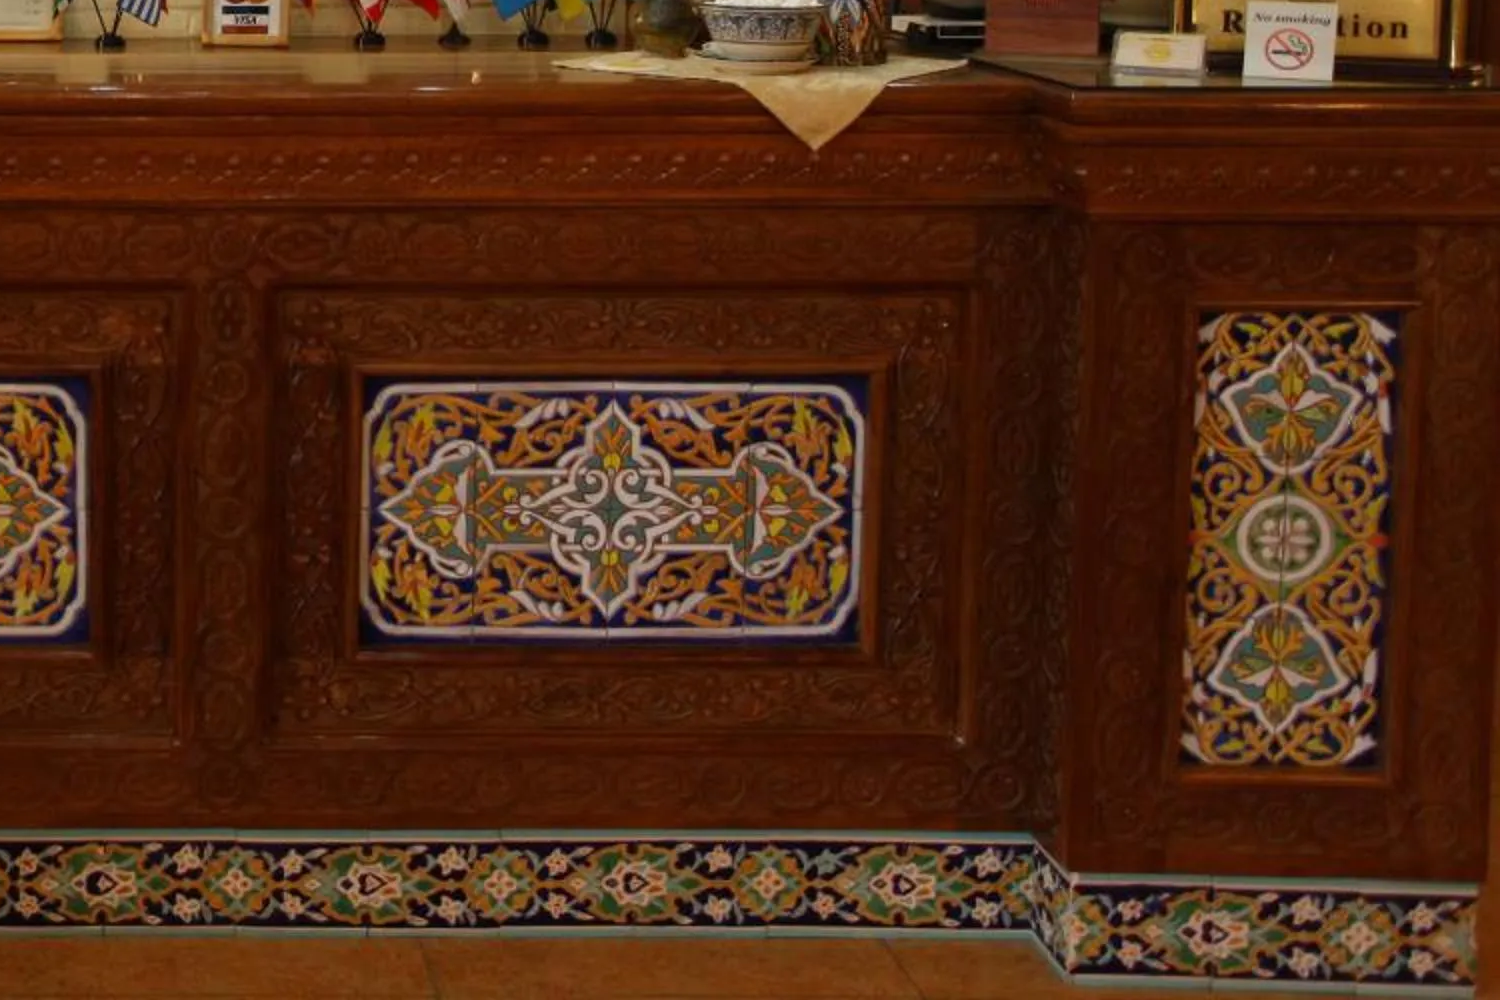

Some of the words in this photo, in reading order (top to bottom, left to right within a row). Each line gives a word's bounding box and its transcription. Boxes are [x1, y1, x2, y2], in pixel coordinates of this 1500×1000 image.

[234, 15, 258, 25] VISA
[1220, 8, 1410, 39] Rtion
[1253, 12, 1272, 24] No
[1273, 13, 1332, 26] smoking
